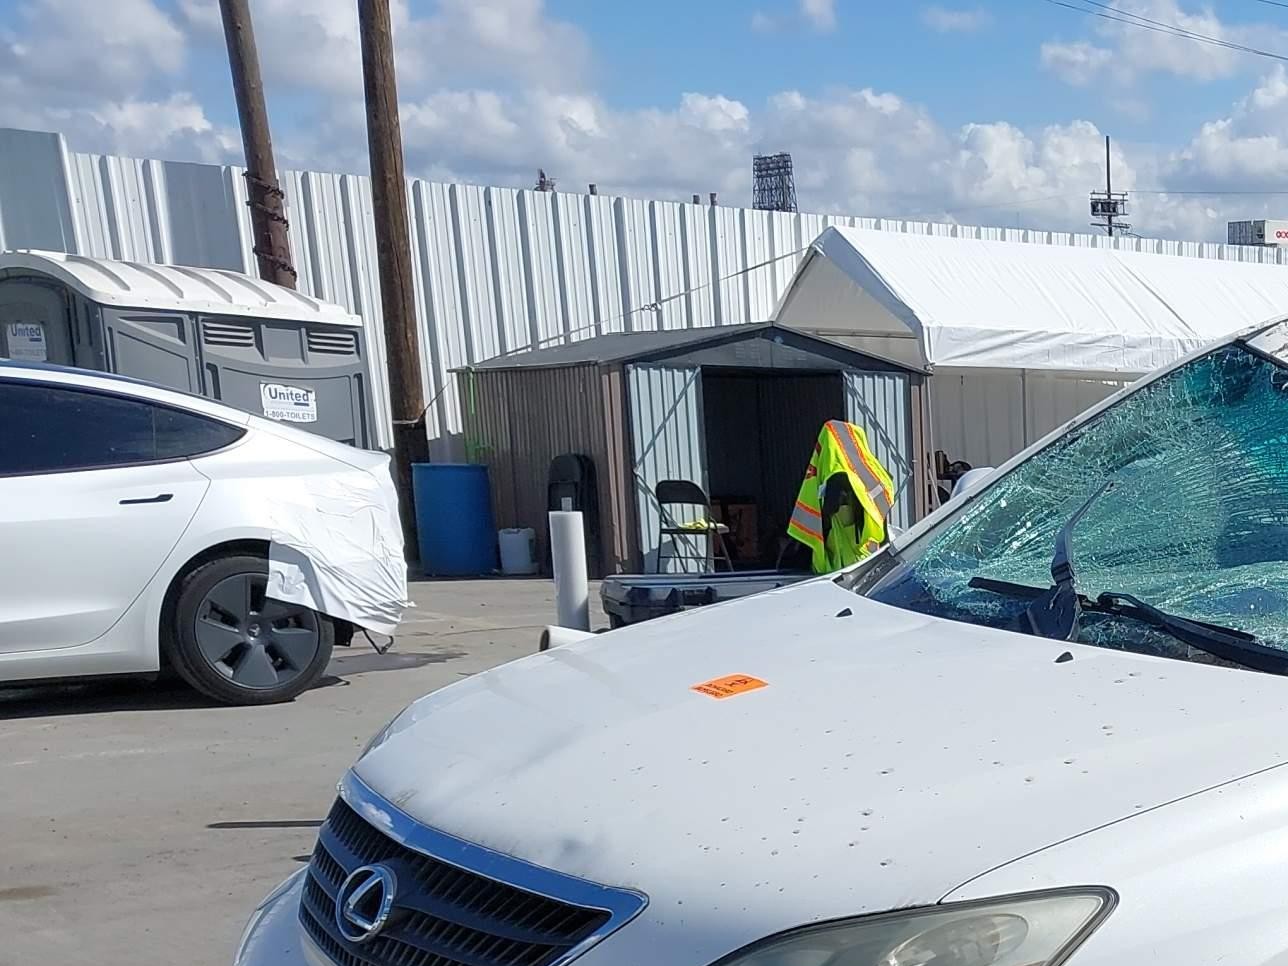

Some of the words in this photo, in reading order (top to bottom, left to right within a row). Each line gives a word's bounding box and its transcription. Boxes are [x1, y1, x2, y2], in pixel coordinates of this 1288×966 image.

[10, 322, 42, 337] United
[268, 387, 309, 402] United
[265, 410, 316, 420] 1-800-TOILETS
